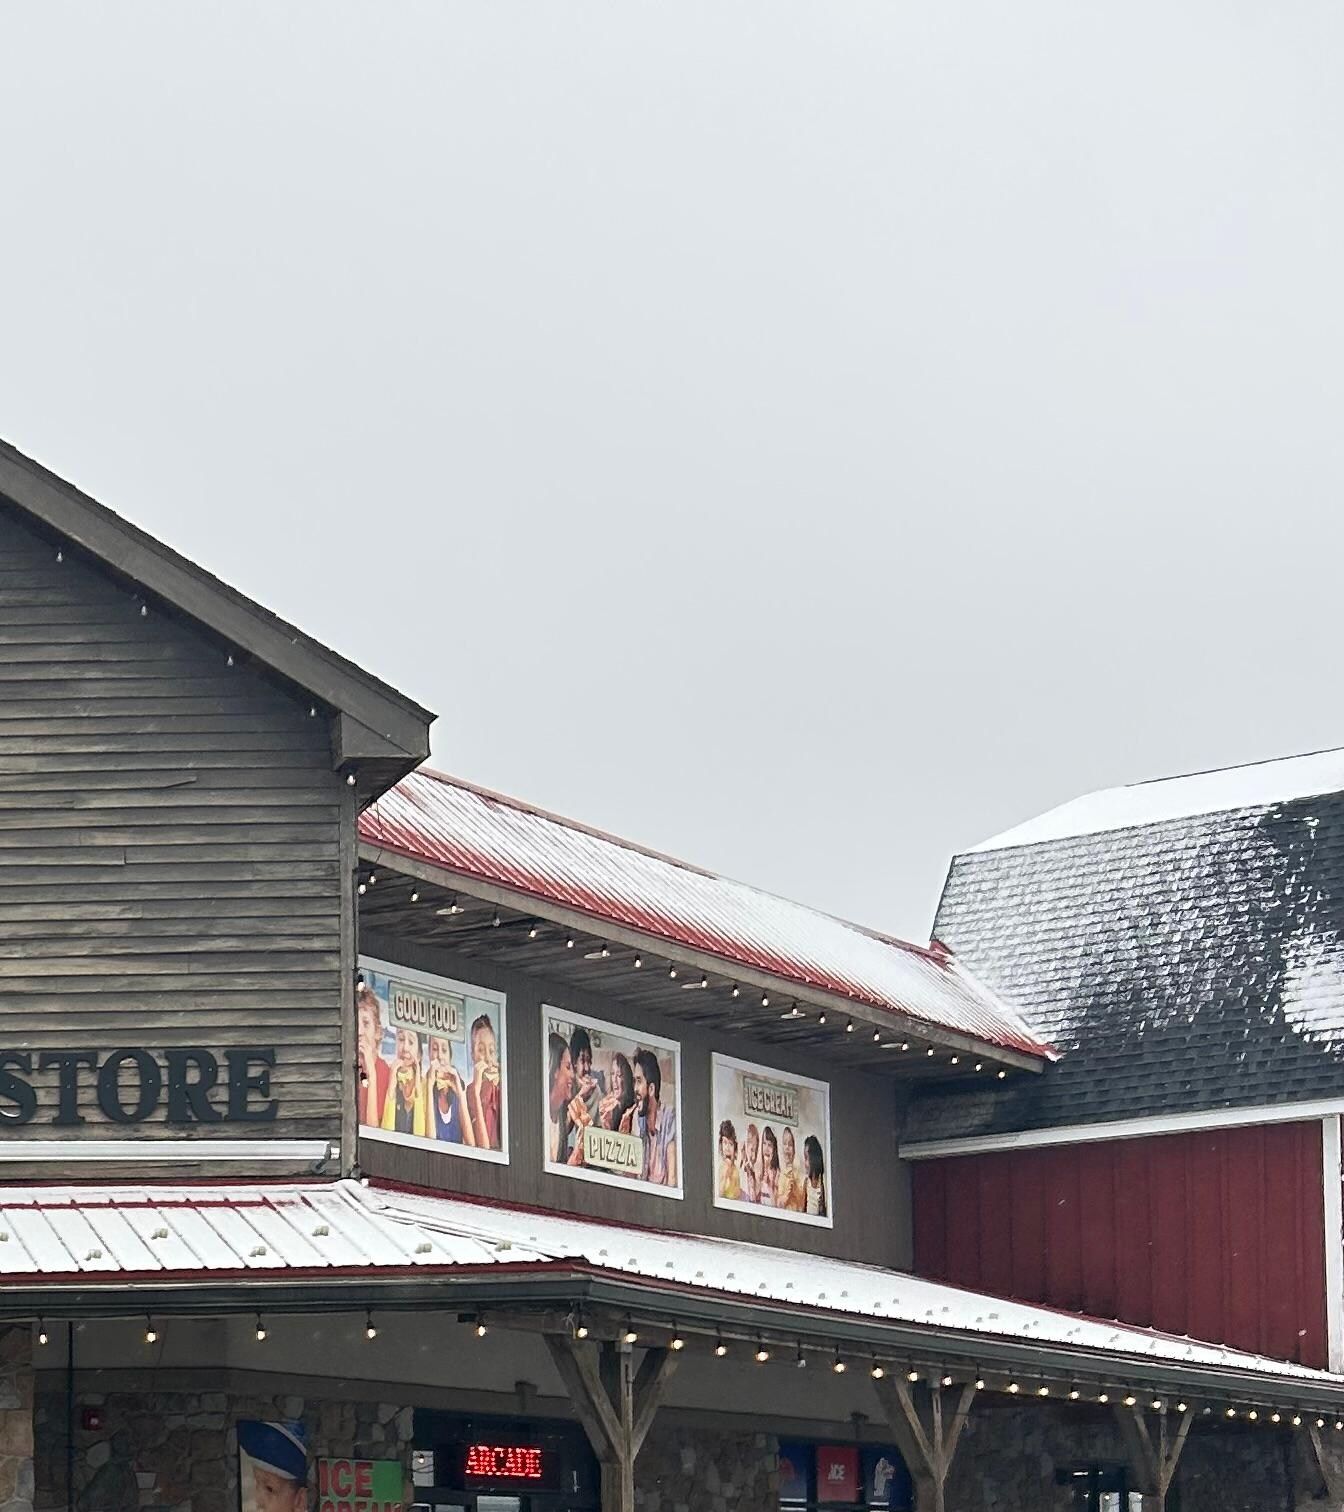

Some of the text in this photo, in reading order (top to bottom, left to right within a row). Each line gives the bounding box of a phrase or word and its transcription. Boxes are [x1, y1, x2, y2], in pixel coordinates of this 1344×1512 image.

[394, 990, 457, 1033] GOOD FOOD
[747, 1085, 793, 1119] ICE CREAM
[589, 1135, 637, 1167] PIZZA
[465, 1445, 542, 1477] ARCADE
[318, 1460, 374, 1498] ICE
